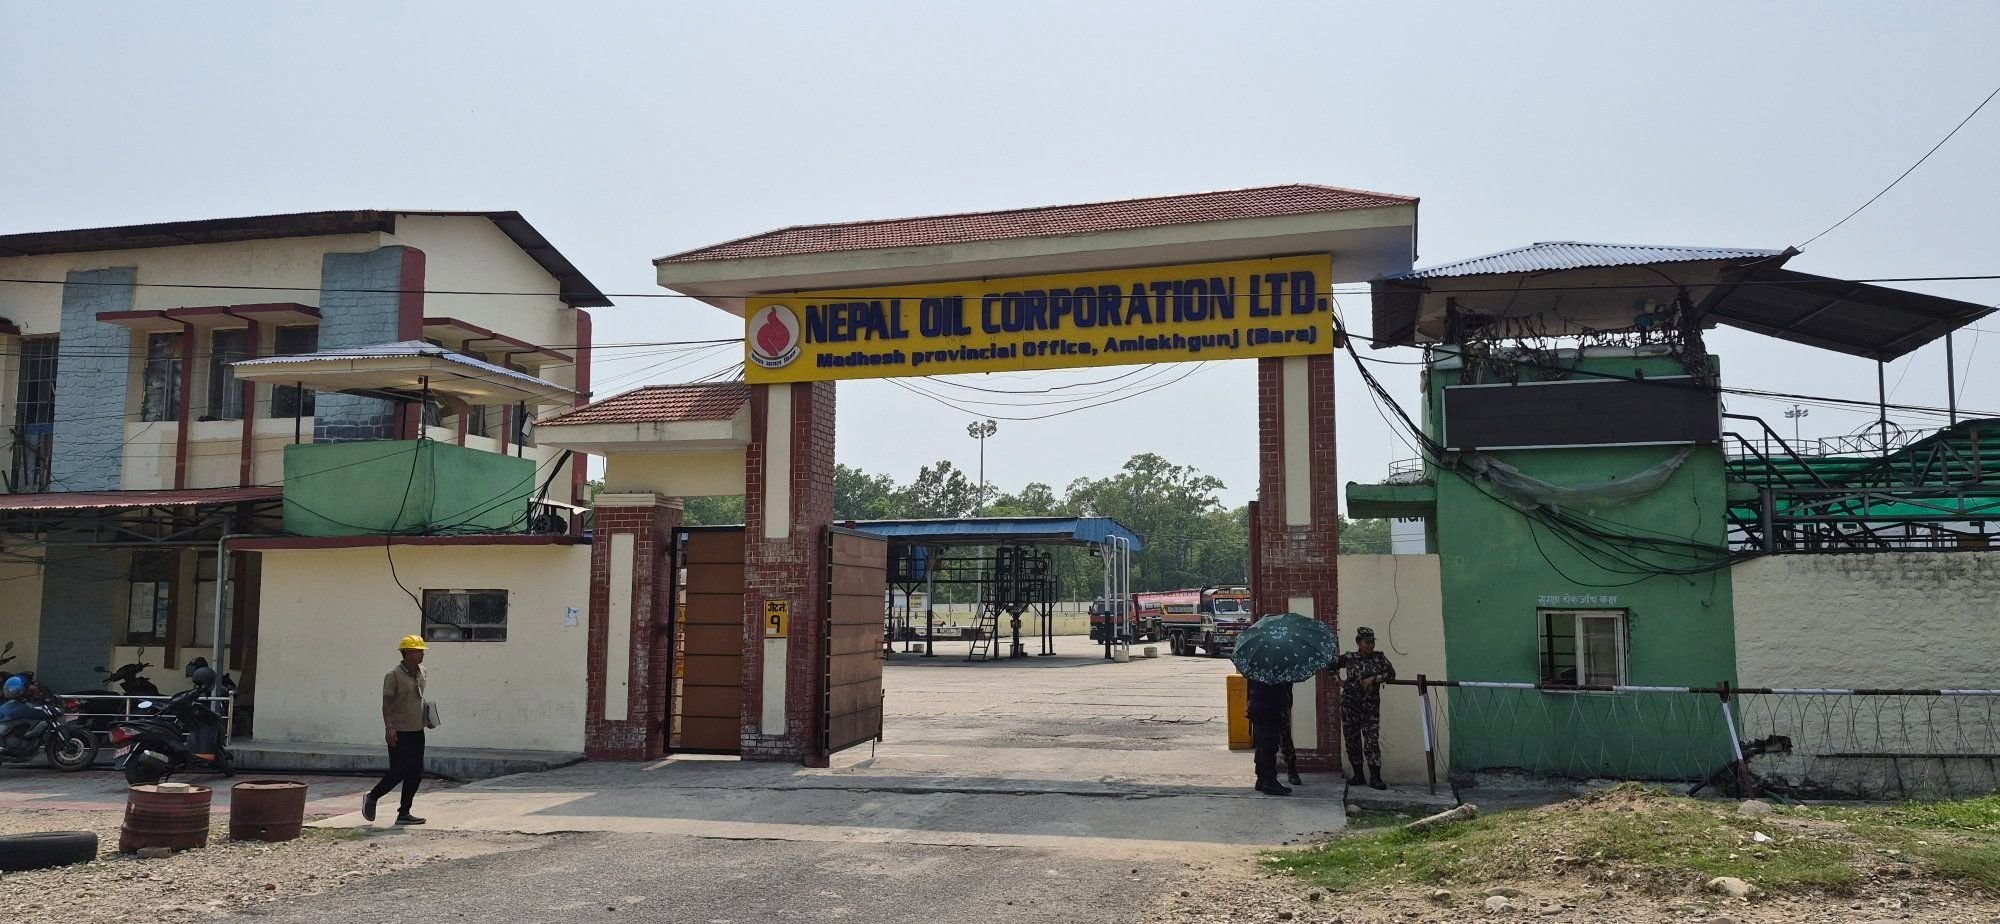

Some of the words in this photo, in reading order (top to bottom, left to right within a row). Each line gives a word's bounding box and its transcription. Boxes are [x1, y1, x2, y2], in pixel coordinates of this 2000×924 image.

[805, 300, 908, 344] NEPAL
[920, 295, 971, 338] OIL
[982, 277, 1235, 334] CORPORATION
[1249, 270, 1328, 317] LTD.
[816, 350, 906, 368] Madhesh
[912, 340, 1017, 366] provincial
[1022, 335, 1098, 356] Office,
[1247, 325, 1317, 346] (Bara)
